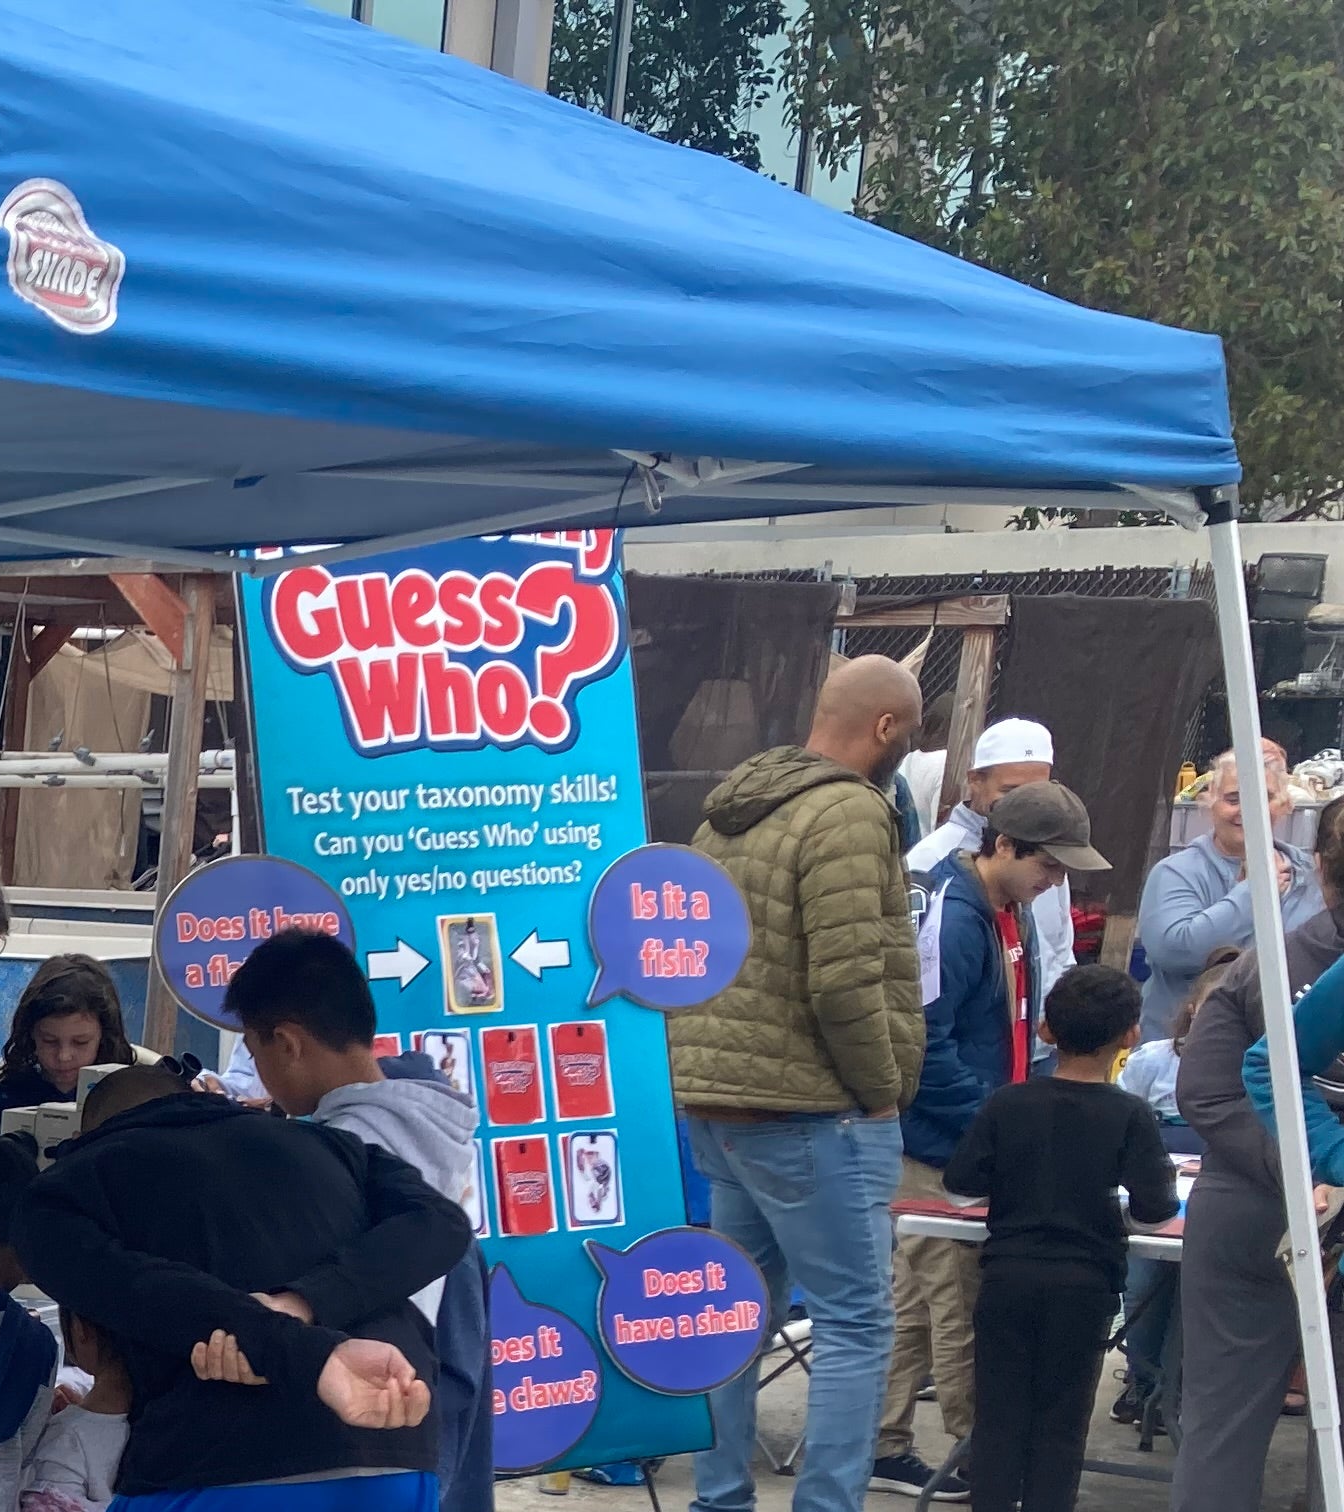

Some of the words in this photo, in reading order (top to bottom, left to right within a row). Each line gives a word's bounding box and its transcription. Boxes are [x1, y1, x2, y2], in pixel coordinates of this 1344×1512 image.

[271, 564, 525, 667] Guess
[286, 786, 343, 816] Test
[349, 787, 410, 820] your
[416, 781, 544, 812] taxonomy
[550, 774, 618, 804] skills!
[314, 831, 357, 856] Can
[363, 832, 404, 861] you
[544, 819, 601, 850] using
[341, 866, 390, 900] only
[395, 865, 467, 899] yes/no
[472, 860, 582, 895] questions?
[631, 882, 658, 919] Is
[663, 881, 687, 919] it
[690, 891, 710, 919] a
[176, 912, 246, 943] Does
[249, 907, 272, 939] it
[185, 964, 204, 988] a
[640, 938, 709, 977] fish?
[643, 1268, 703, 1298] Does
[705, 1261, 726, 1291] it
[614, 1313, 675, 1344] have
[677, 1314, 693, 1337] a
[696, 1300, 760, 1335] shell?
[490, 1334, 536, 1366] oes
[537, 1325, 562, 1359] it
[510, 1370, 597, 1412] claws?
